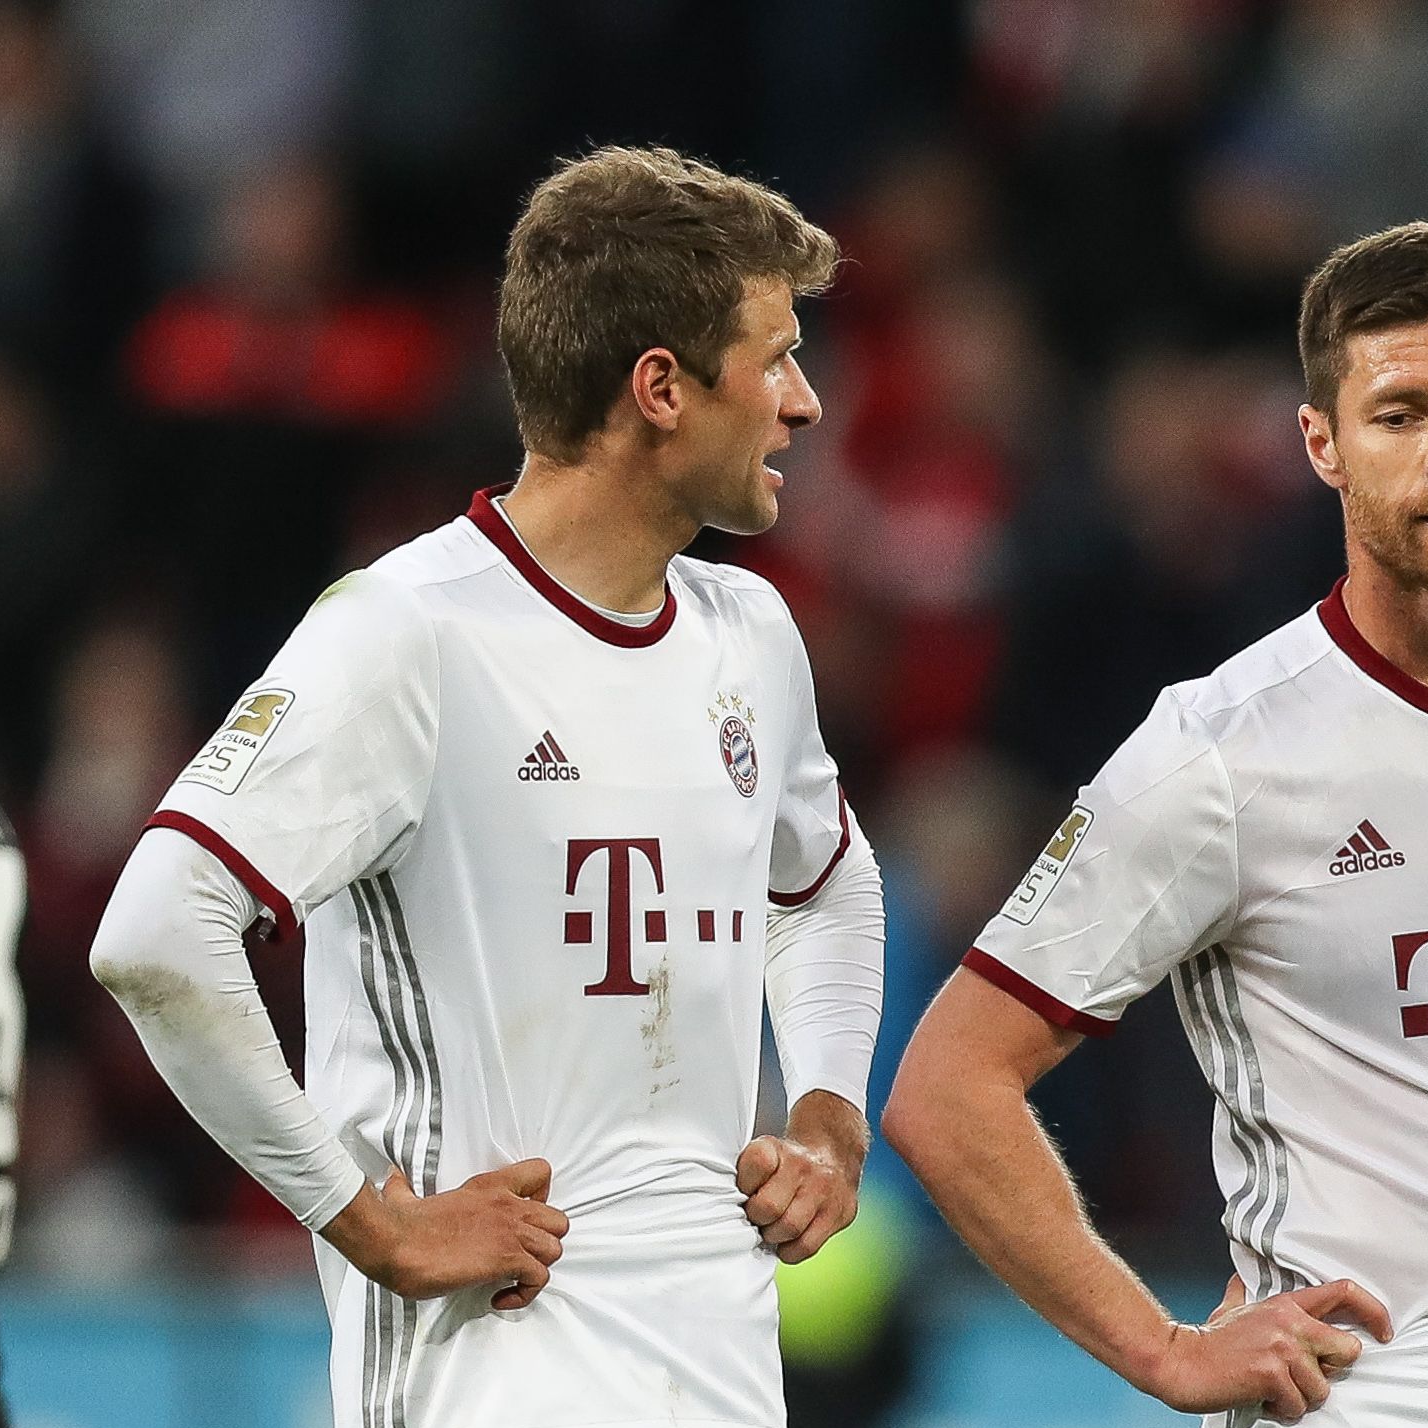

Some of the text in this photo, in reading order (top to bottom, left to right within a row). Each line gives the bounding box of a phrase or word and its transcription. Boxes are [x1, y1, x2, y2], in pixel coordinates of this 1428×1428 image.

[191, 745, 237, 772] 25
[517, 761, 581, 781] adidas
[1329, 851, 1406, 876] adidas
